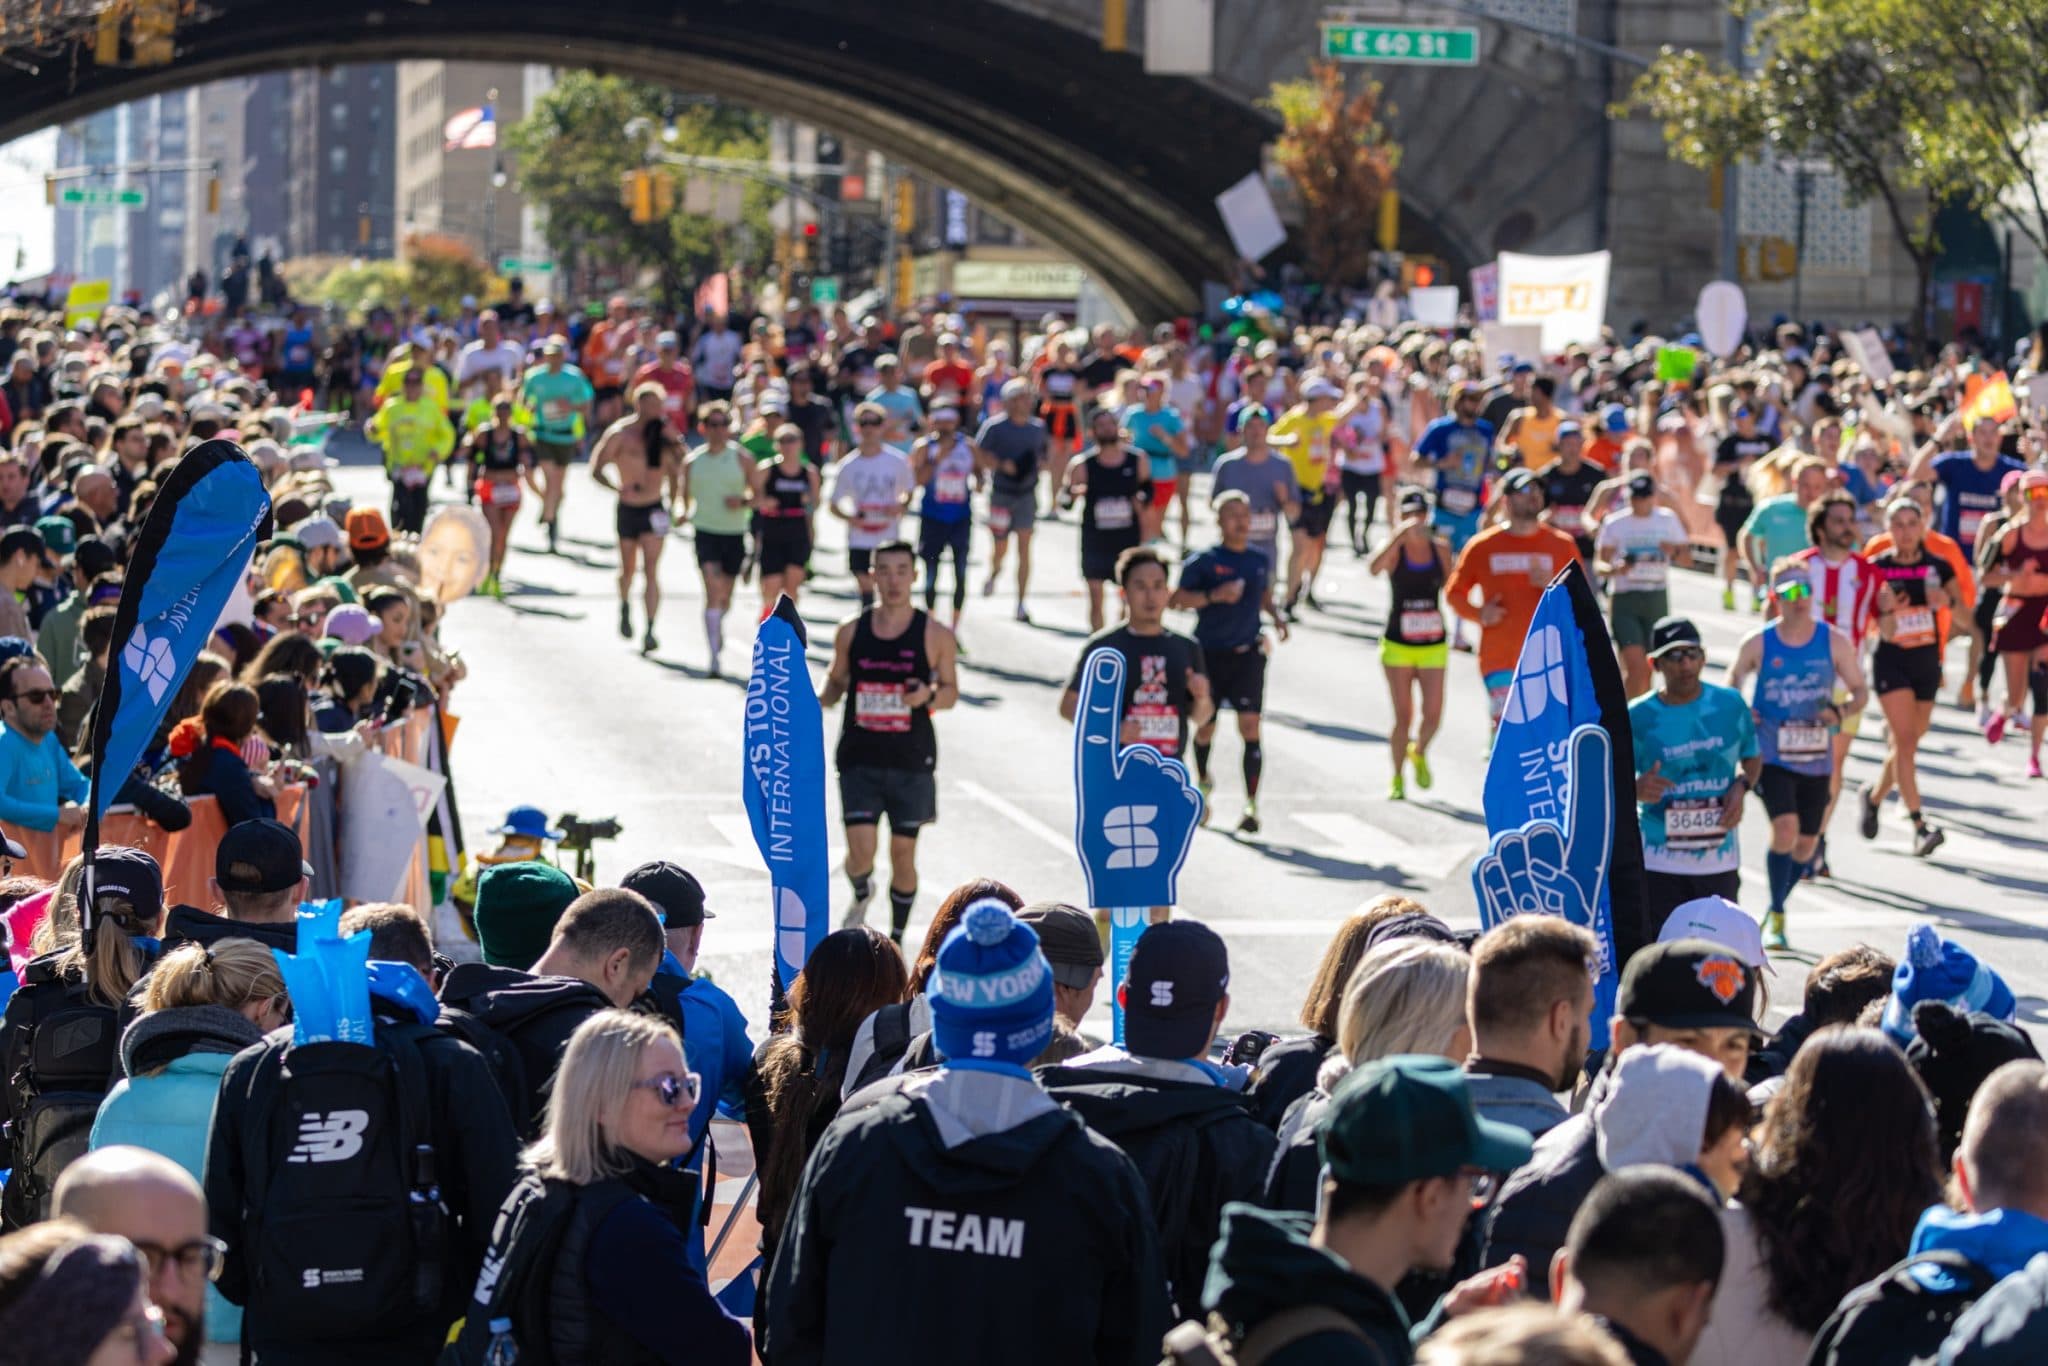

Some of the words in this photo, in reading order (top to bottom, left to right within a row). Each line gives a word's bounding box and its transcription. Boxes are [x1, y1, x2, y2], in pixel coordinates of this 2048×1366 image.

[1351, 31, 1368, 53] E
[1375, 33, 1411, 57] 60
[768, 638, 793, 863] INTERNATIONAL
[904, 1205, 1025, 1259] TEAM
